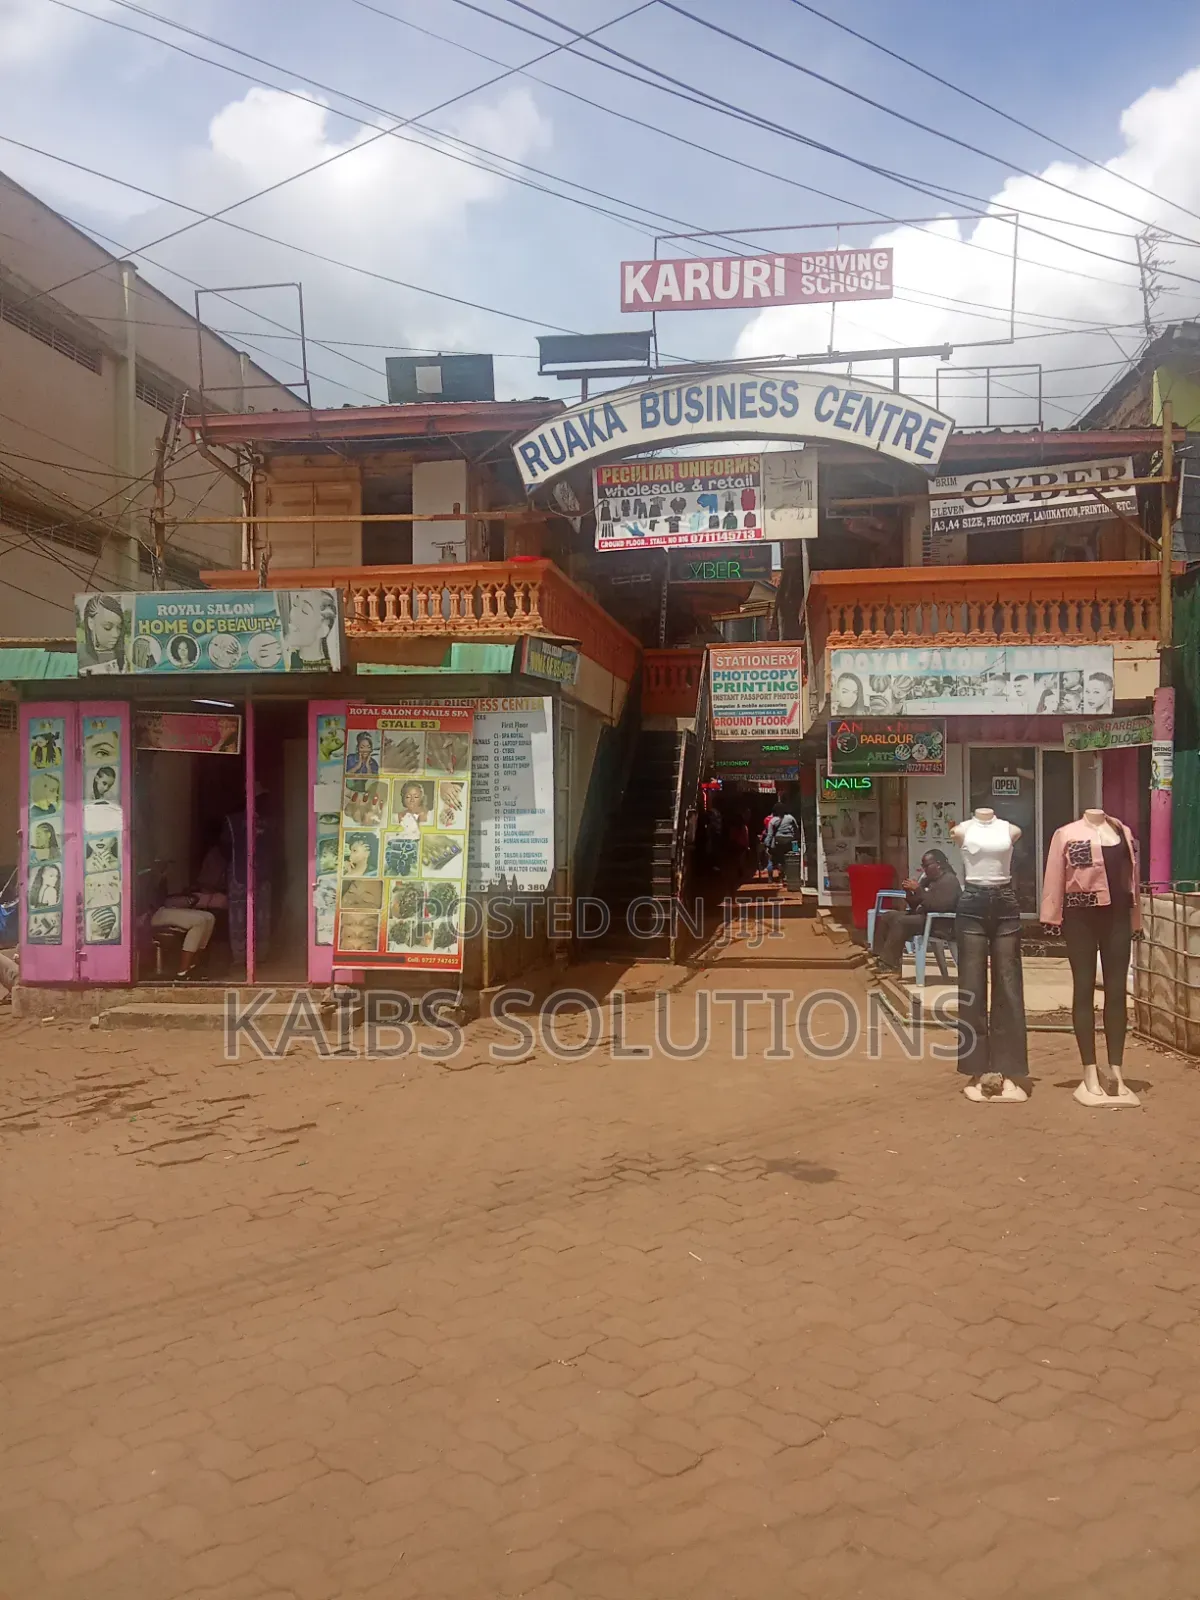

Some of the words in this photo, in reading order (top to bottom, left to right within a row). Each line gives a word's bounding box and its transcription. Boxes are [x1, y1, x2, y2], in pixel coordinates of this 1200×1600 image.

[801, 251, 889, 275] DRIVING
[625, 257, 786, 304] KARURI
[801, 270, 891, 297] SCHOOL
[518, 401, 628, 478] RUAKA
[640, 379, 800, 430] BUSINESS
[813, 384, 948, 460] CENTRE
[602, 462, 675, 484] PECULIAR
[678, 455, 760, 479] UNIFORMS
[605, 481, 685, 498] wholesale
[692, 479, 704, 492] &
[708, 474, 754, 490] retail
[935, 477, 957, 488] BRIM
[963, 464, 1133, 509] CYBER
[931, 505, 965, 517] ELEVEN
[600, 540, 625, 549] GROUND
[650, 536, 668, 546] STALL
[156, 603, 205, 616] ROYAL
[206, 602, 255, 616] SALON
[138, 619, 188, 635] HOME
[192, 618, 216, 634] OF
[217, 616, 281, 633] BEAUTY
[716, 654, 796, 667] STATIONERY
[713, 669, 798, 681] PHOTOCOPY
[713, 681, 799, 693] PRINTING
[740, 693, 772, 701] PASSPORT
[773, 692, 799, 700] PHOTOS
[381, 708, 412, 716] SALON
[422, 709, 450, 717] NAILS
[381, 720, 417, 729] STALL
[420, 721, 436, 729] B3
[713, 716, 753, 727] GROUND
[755, 716, 787, 726] FLOOR
[860, 734, 914, 744] PARLOUR
[867, 752, 895, 761] ARTS
[825, 777, 872, 789] NAILS
[995, 779, 1017, 790] OPEN
